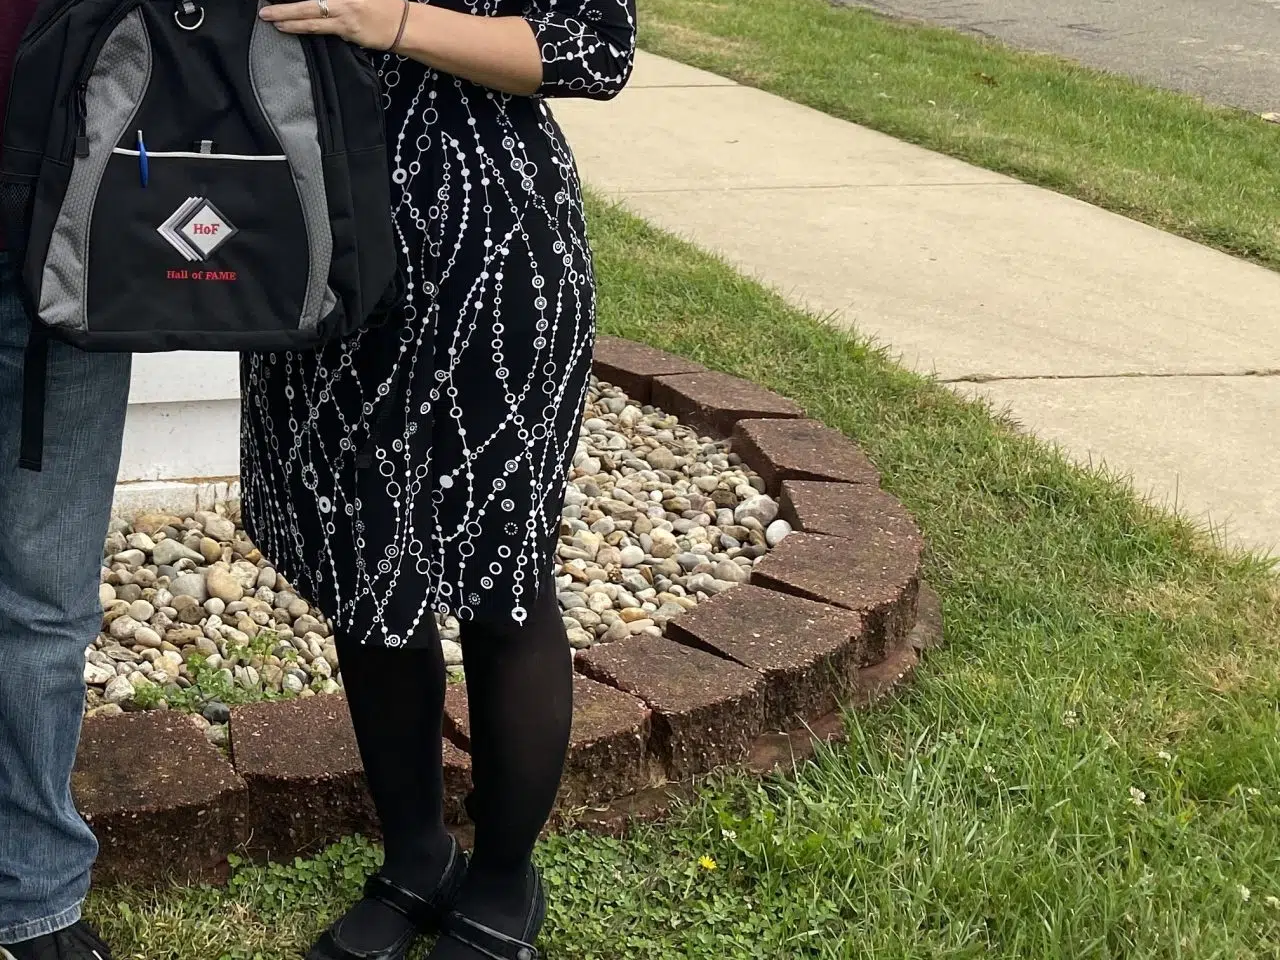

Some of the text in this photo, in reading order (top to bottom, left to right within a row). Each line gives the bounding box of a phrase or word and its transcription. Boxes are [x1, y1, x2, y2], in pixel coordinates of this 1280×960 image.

[193, 223, 220, 235] HoF
[166, 270, 237, 281] Hall of FAME
